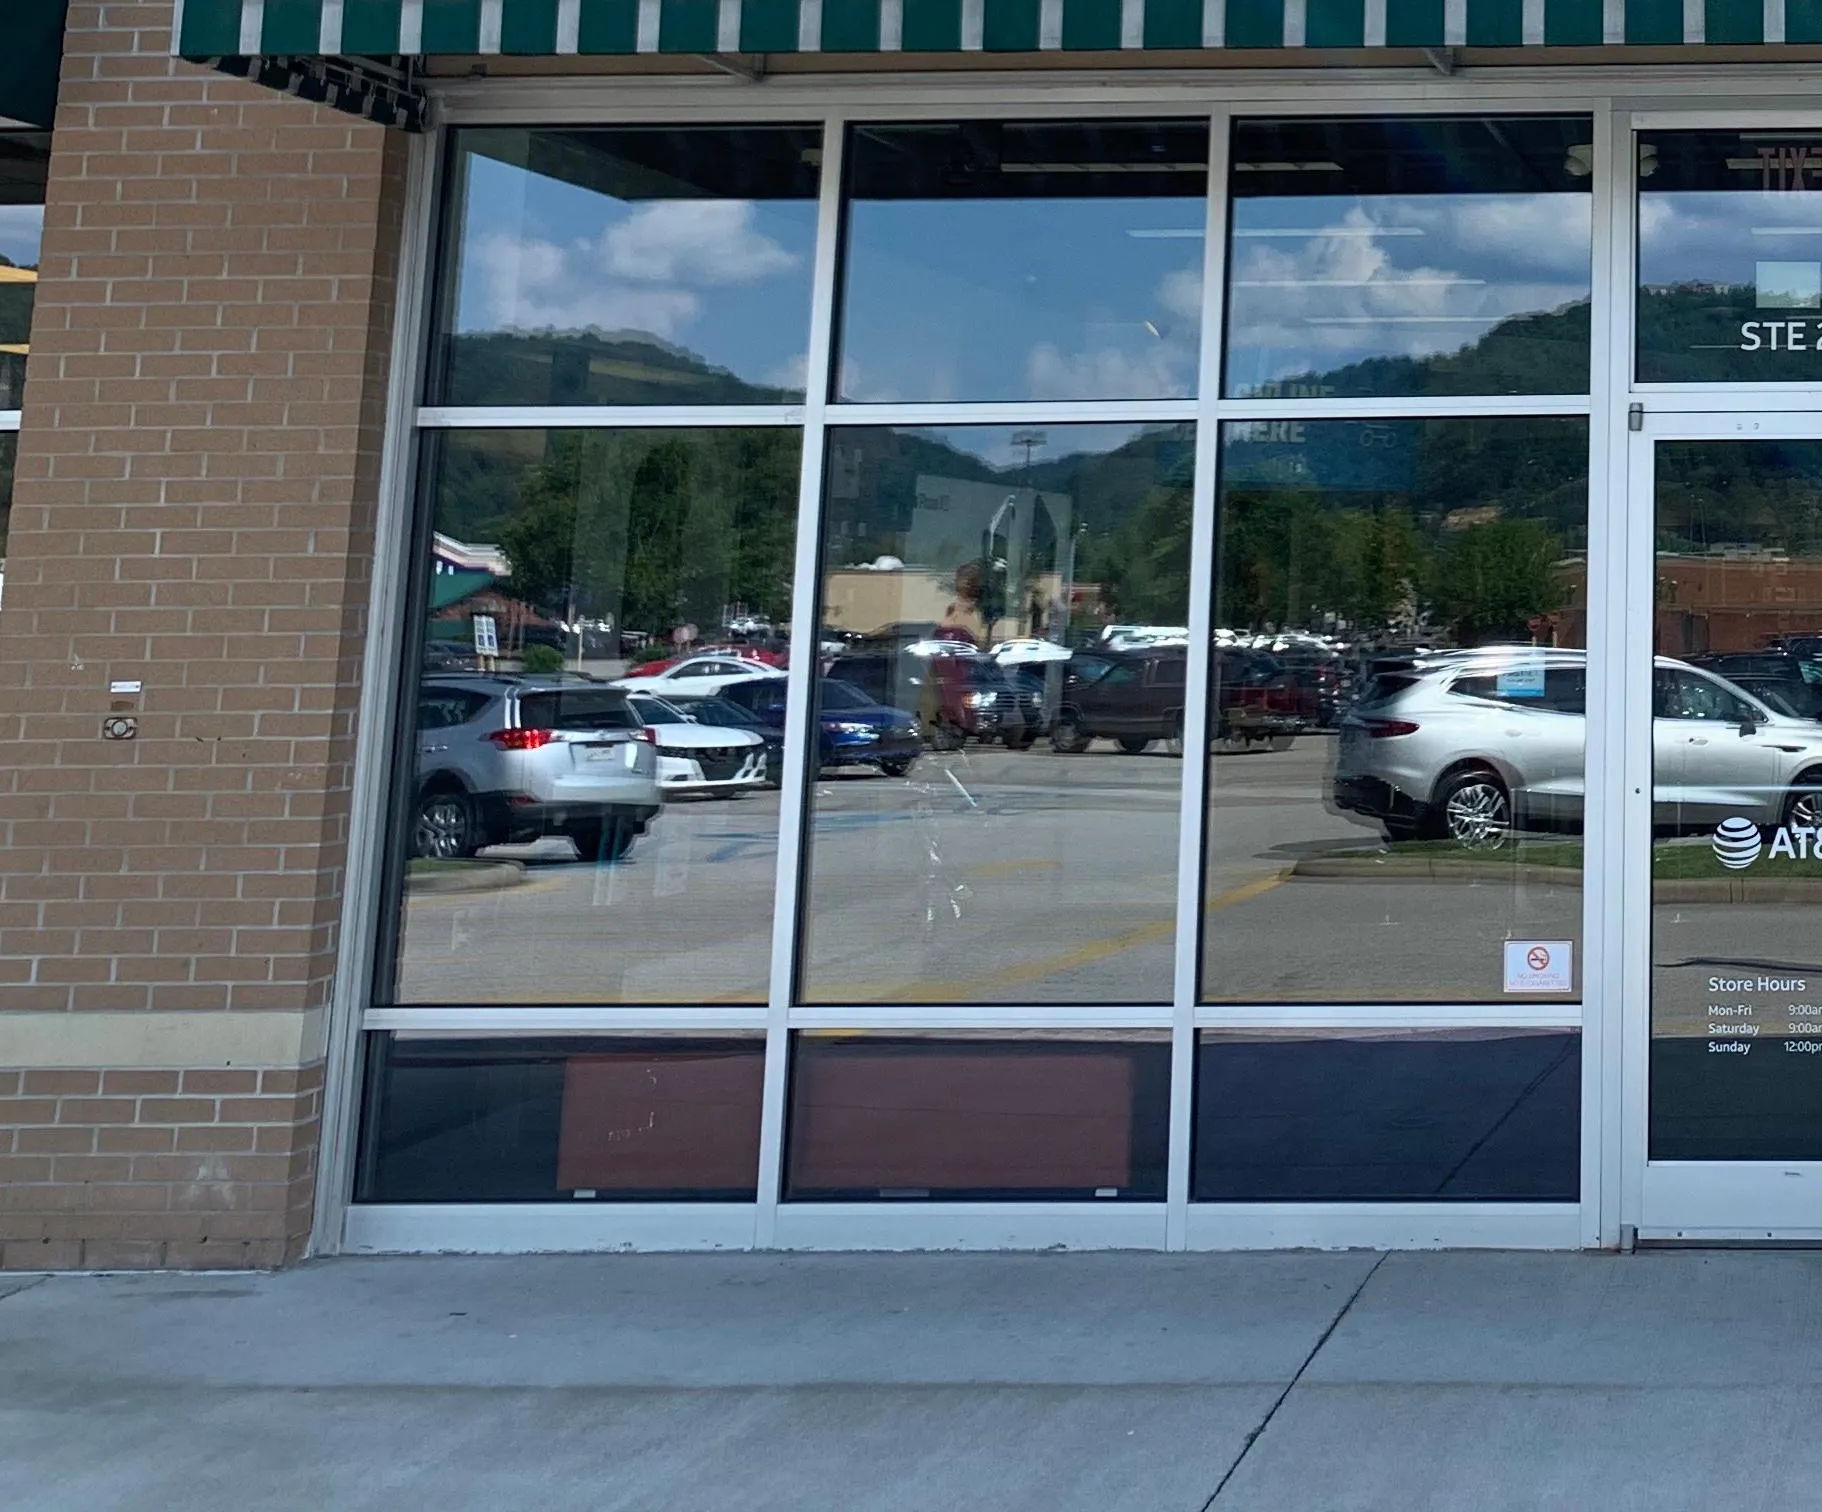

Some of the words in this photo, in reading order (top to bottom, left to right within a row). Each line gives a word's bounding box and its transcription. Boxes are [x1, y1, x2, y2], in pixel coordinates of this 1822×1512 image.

[1740, 321, 1807, 351] STE
[1708, 976, 1754, 992] Store
[1757, 976, 1807, 992] Hours
[1708, 1005, 1753, 1016] Mon-Fri
[1708, 1022, 1760, 1036] Saturday
[1708, 1040, 1751, 1055] Sunday
